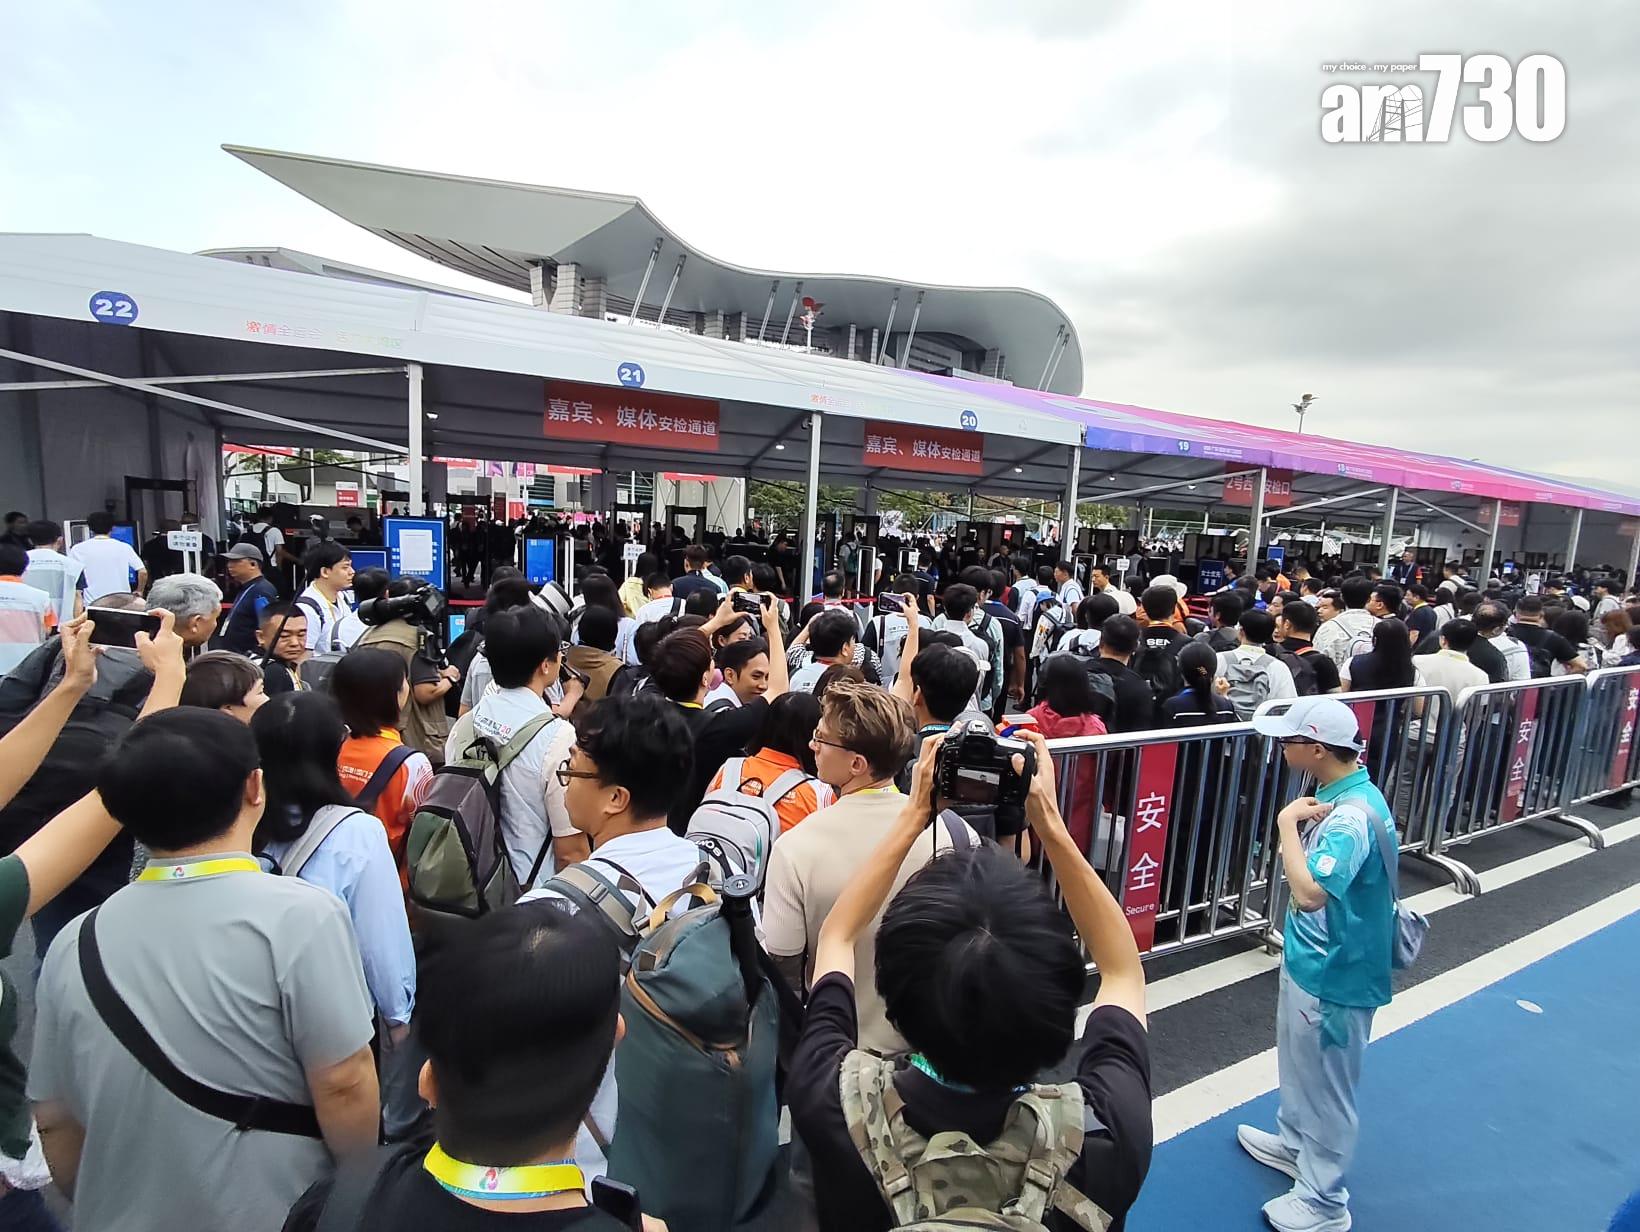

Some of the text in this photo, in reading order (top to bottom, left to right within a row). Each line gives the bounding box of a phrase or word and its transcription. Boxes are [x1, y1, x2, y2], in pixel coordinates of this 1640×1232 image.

[95, 298, 133, 318] 22
[620, 367, 642, 383] 21
[961, 414, 977, 428] 20
[1178, 440, 1190, 451] 19
[1510, 718, 1532, 781] 安全
[1129, 791, 1166, 891] 安全
[1125, 903, 1155, 916] Secure
